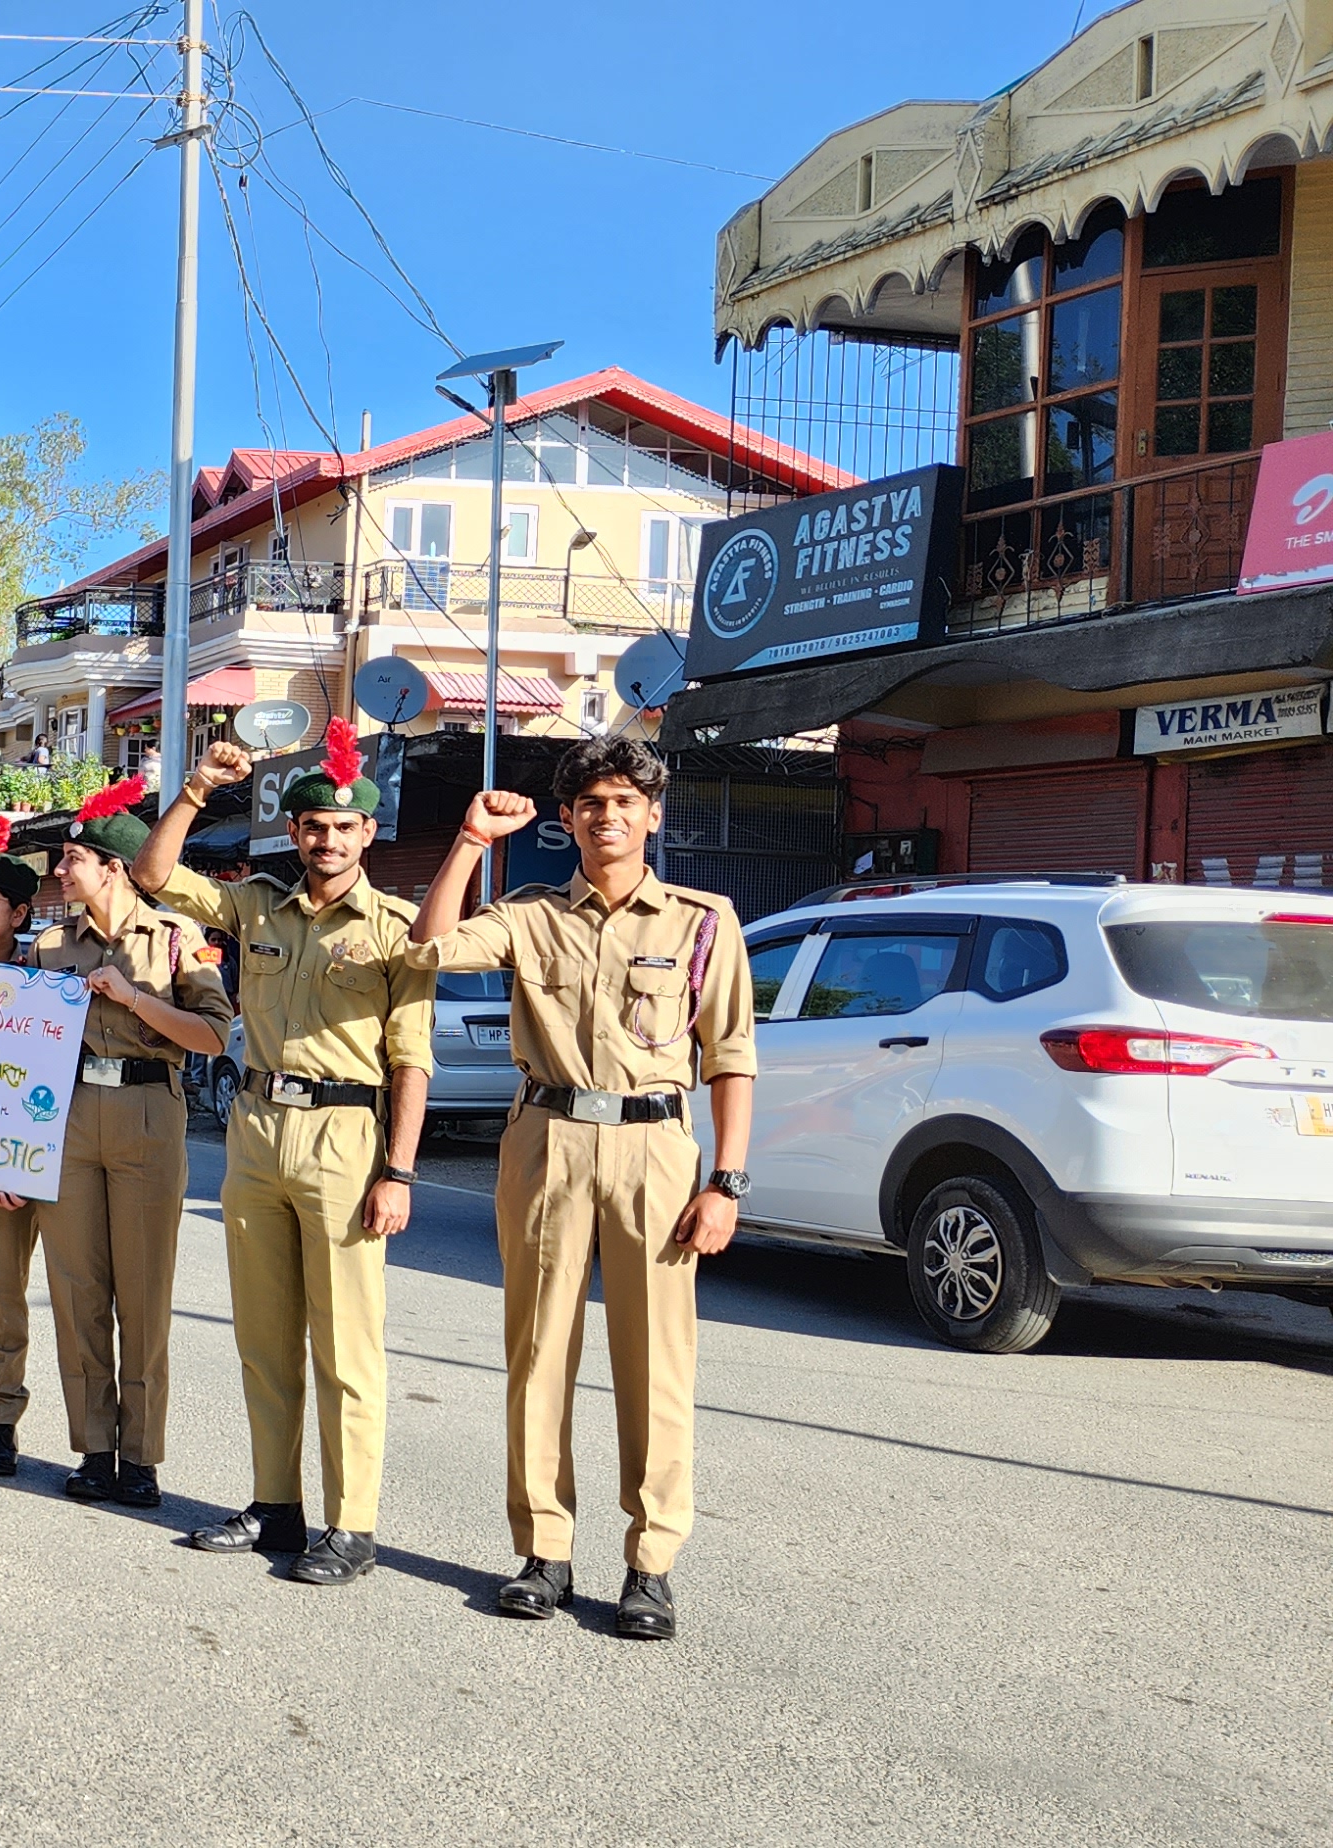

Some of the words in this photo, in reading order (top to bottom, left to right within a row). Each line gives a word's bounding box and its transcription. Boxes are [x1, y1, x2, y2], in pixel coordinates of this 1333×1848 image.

[793, 485, 922, 546] AGASTYA
[795, 524, 912, 580] FITNESS
[1286, 533, 1312, 550] THE
[710, 539, 747, 592] AGASTYA
[748, 538, 773, 579] FITNESS
[863, 567, 900, 582] RESULTS
[784, 597, 826, 615] STRENGTH
[832, 587, 873, 606] TRAINING
[879, 579, 914, 596] CARDIO
[1155, 697, 1277, 736] VERMA
[1183, 733, 1218, 746] MAIN
[1222, 726, 1282, 742] MARKET
[41, 1019, 65, 1041] THE
